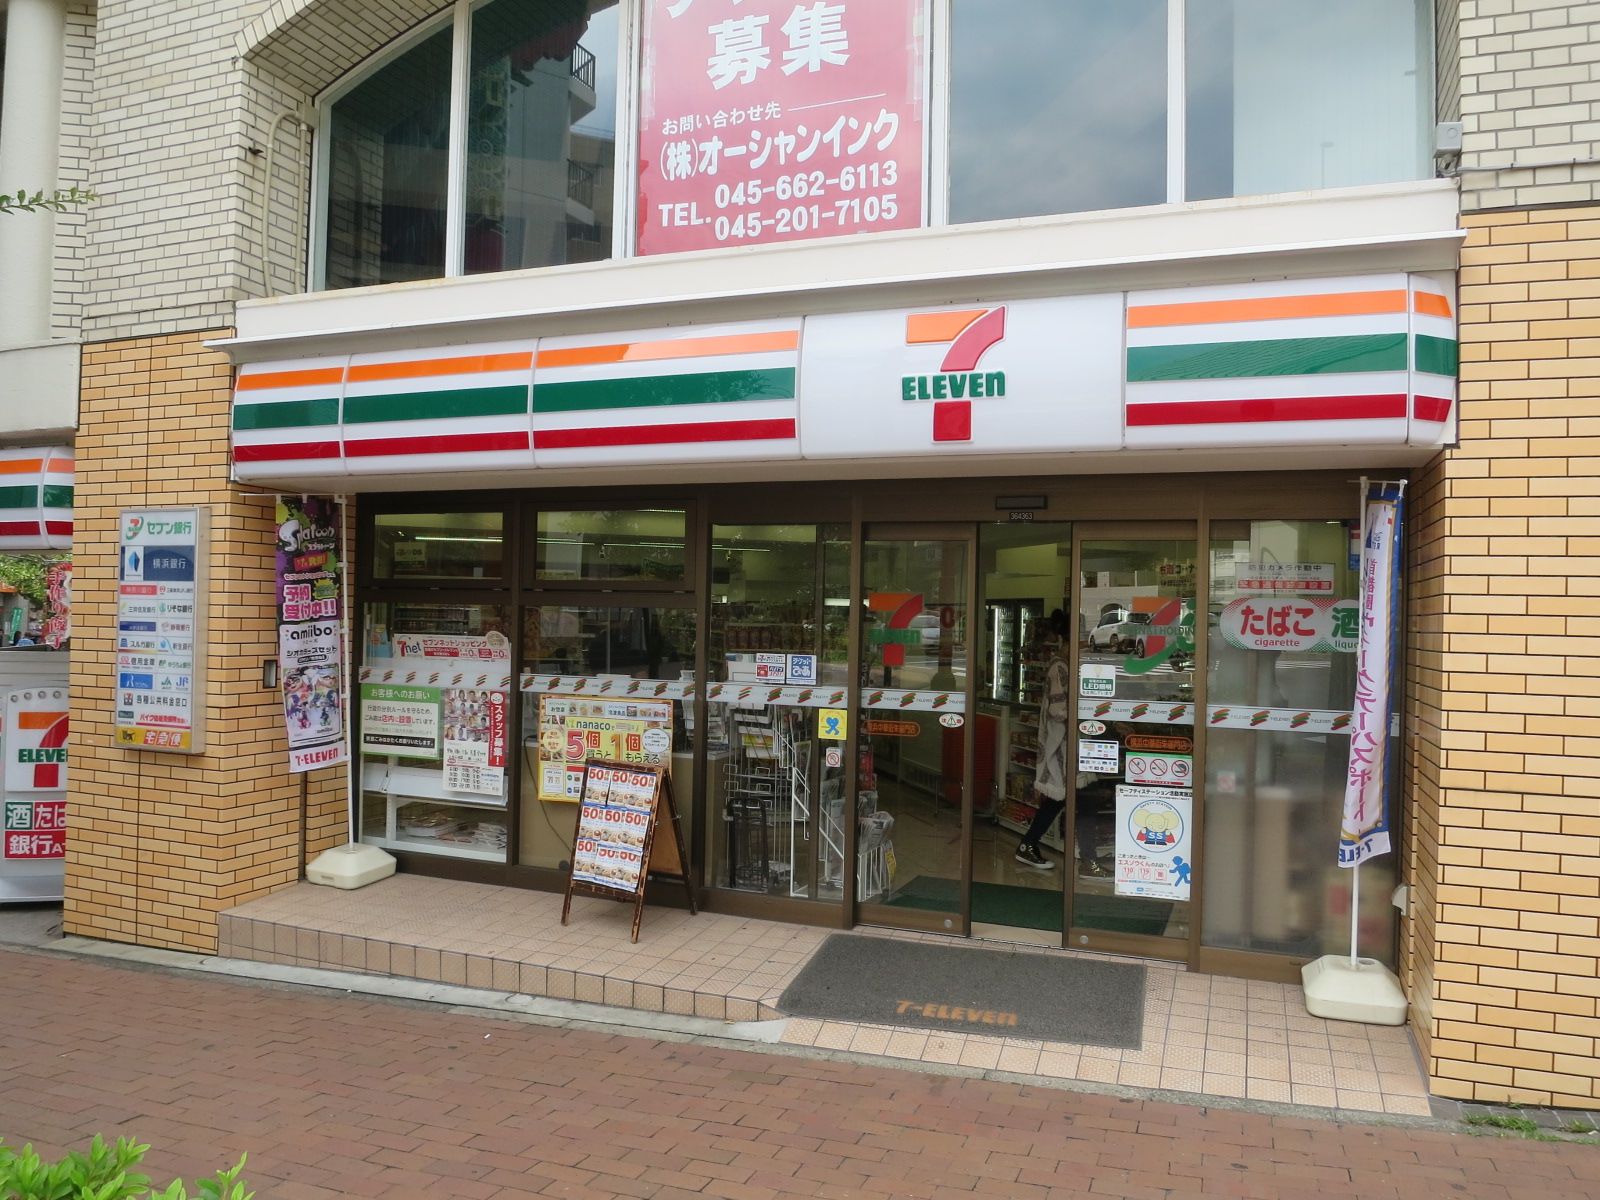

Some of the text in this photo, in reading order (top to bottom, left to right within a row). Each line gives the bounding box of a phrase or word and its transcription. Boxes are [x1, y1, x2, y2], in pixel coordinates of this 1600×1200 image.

[707, 1, 850, 89] 募集
[661, 101, 782, 135] お問い合わせ先
[714, 160, 899, 209] 045-662-6113
[658, 202, 713, 227] TEL.
[714, 194, 899, 241] 045-201-7105
[906, 306, 1006, 442] 7
[147, 521, 192, 535] セブン銀行
[279, 519, 336, 552] Splatoon
[153, 558, 187, 569] 横浜銀行
[284, 584, 312, 603] 予約
[167, 604, 193, 614] りそな銀行
[1240, 605, 1316, 637] たばこ
[1331, 606, 1360, 638] 酒
[290, 625, 333, 640] amiibo
[422, 639, 488, 648] セブンネットショッピング
[1254, 639, 1301, 648] cigarette
[792, 665, 812, 677] ぴあ
[161, 677, 172, 686] JA
[176, 676, 189, 687] JP
[370, 688, 431, 700] お客様へのお願い
[576, 720, 611, 731] nanaco
[145, 730, 182, 745] 宅急便
[18, 748, 69, 763] ELEVE
[625, 752, 661, 765] もらえる
[6, 803, 32, 829] 酒
[1147, 832, 1164, 840] SS
[9, 834, 66, 855] 銀行A
